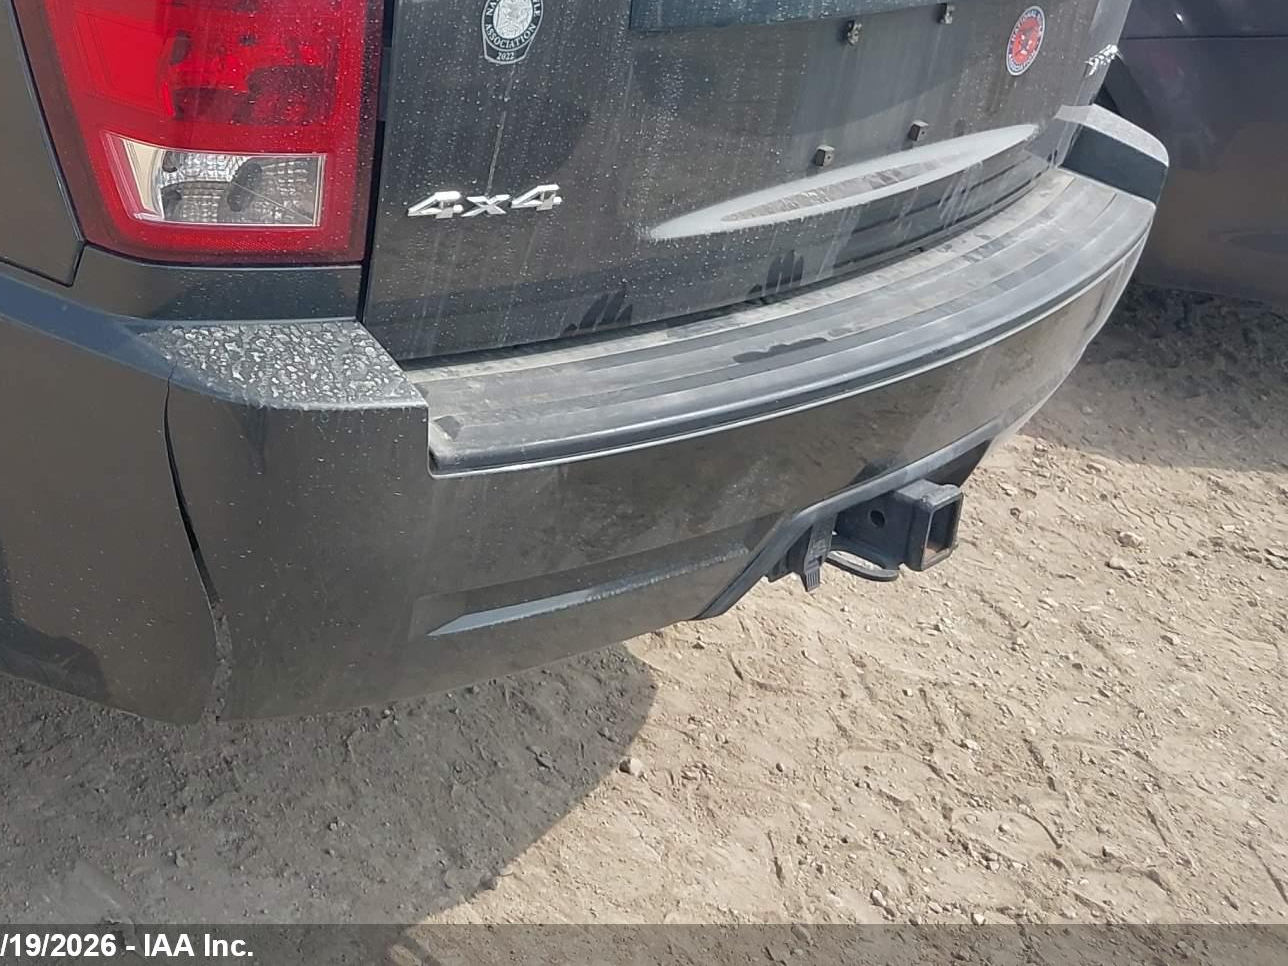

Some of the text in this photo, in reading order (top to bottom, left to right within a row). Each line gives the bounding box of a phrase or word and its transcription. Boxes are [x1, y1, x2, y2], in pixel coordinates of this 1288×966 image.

[485, 23, 537, 49] ASSOCIATION
[496, 51, 515, 61] 2022
[408, 184, 562, 219] 4x4
